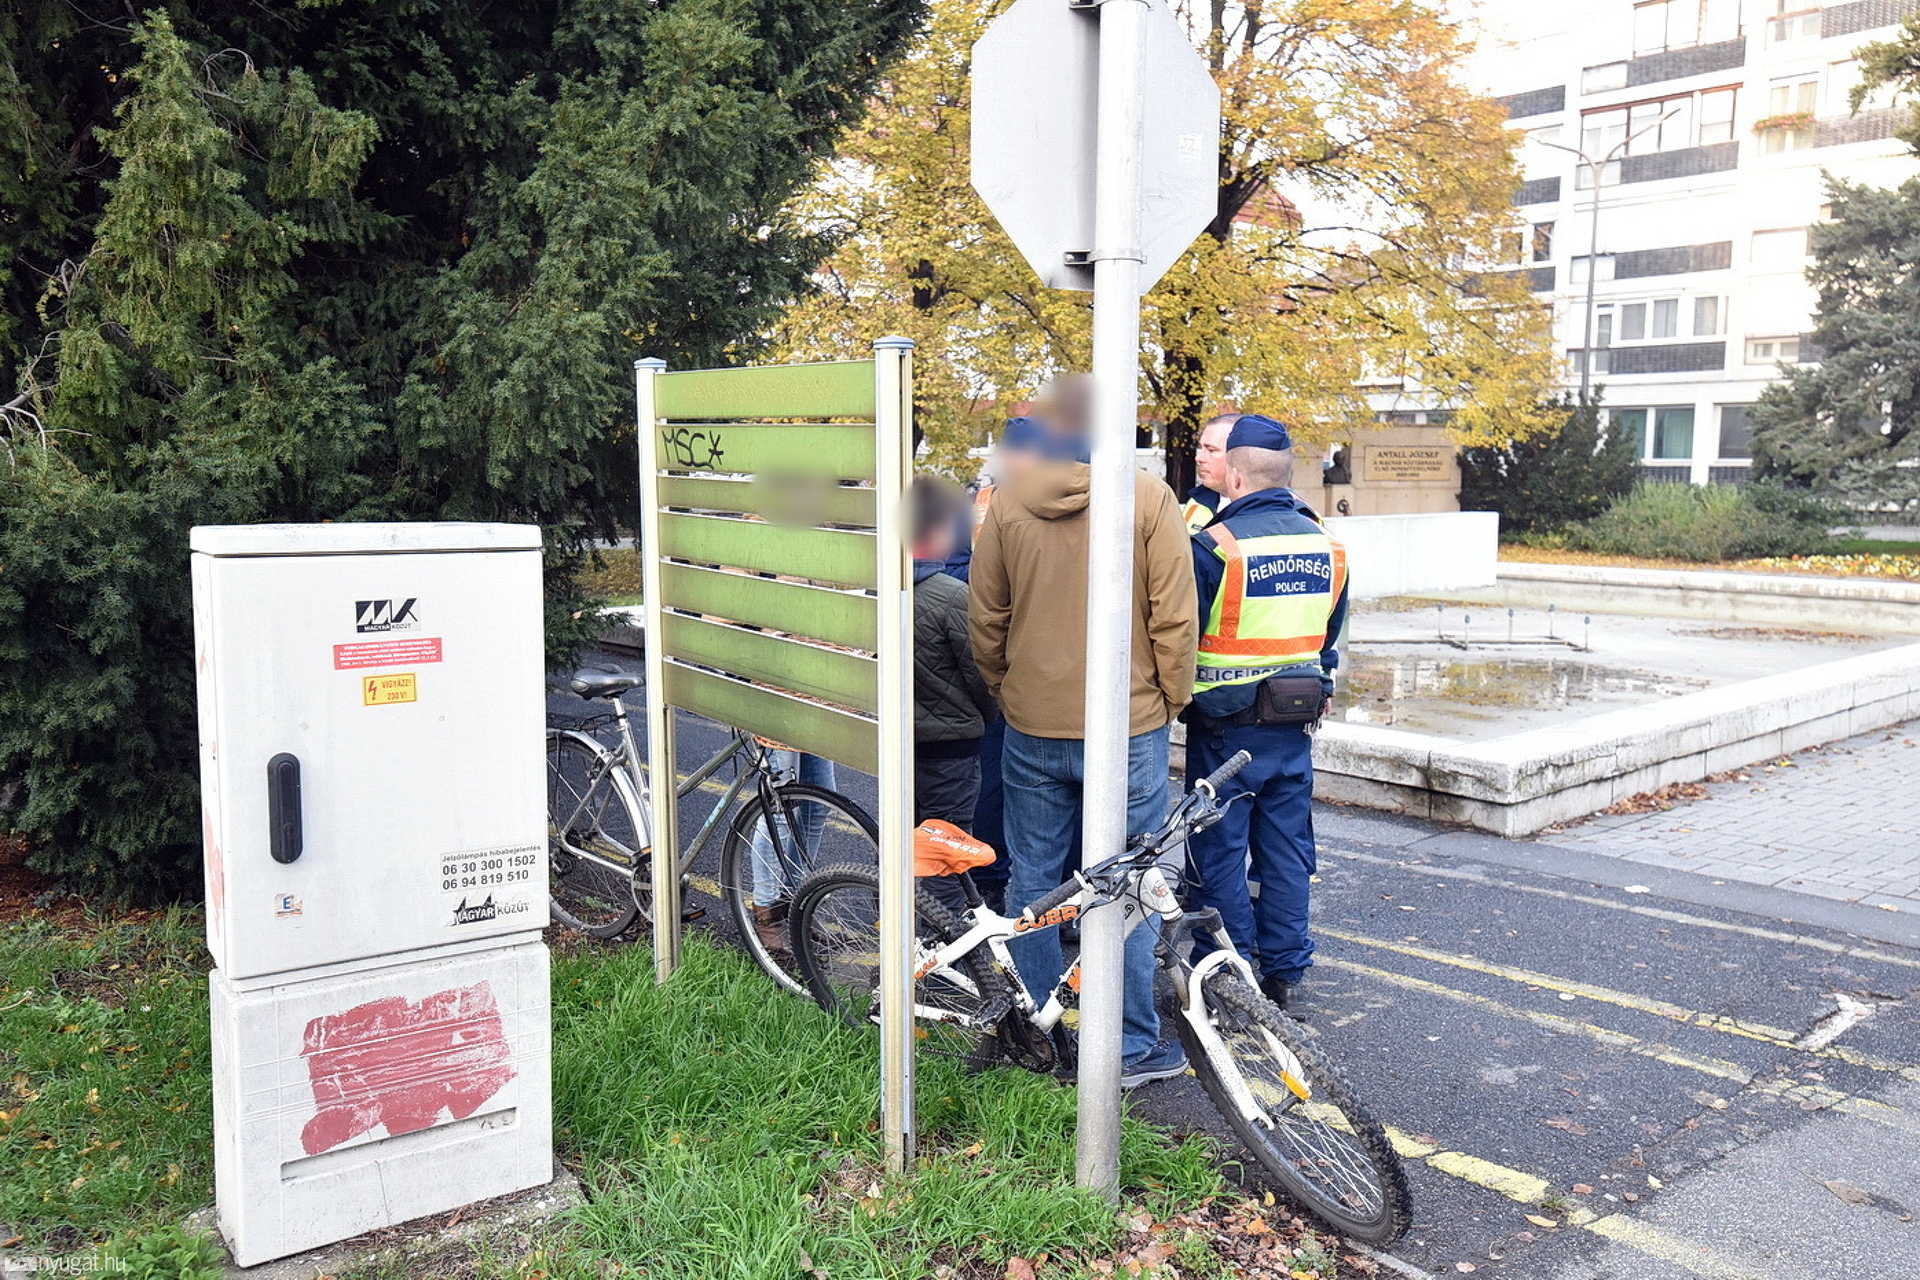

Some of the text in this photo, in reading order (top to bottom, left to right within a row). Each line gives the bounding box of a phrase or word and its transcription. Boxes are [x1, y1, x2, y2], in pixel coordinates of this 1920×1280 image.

[1249, 555, 1331, 583] RENDŐRSÉG
[1275, 581, 1307, 593] POLICE
[442, 854, 535, 875] 06 30 300 1502
[442, 870, 528, 890] 06 94 819 510
